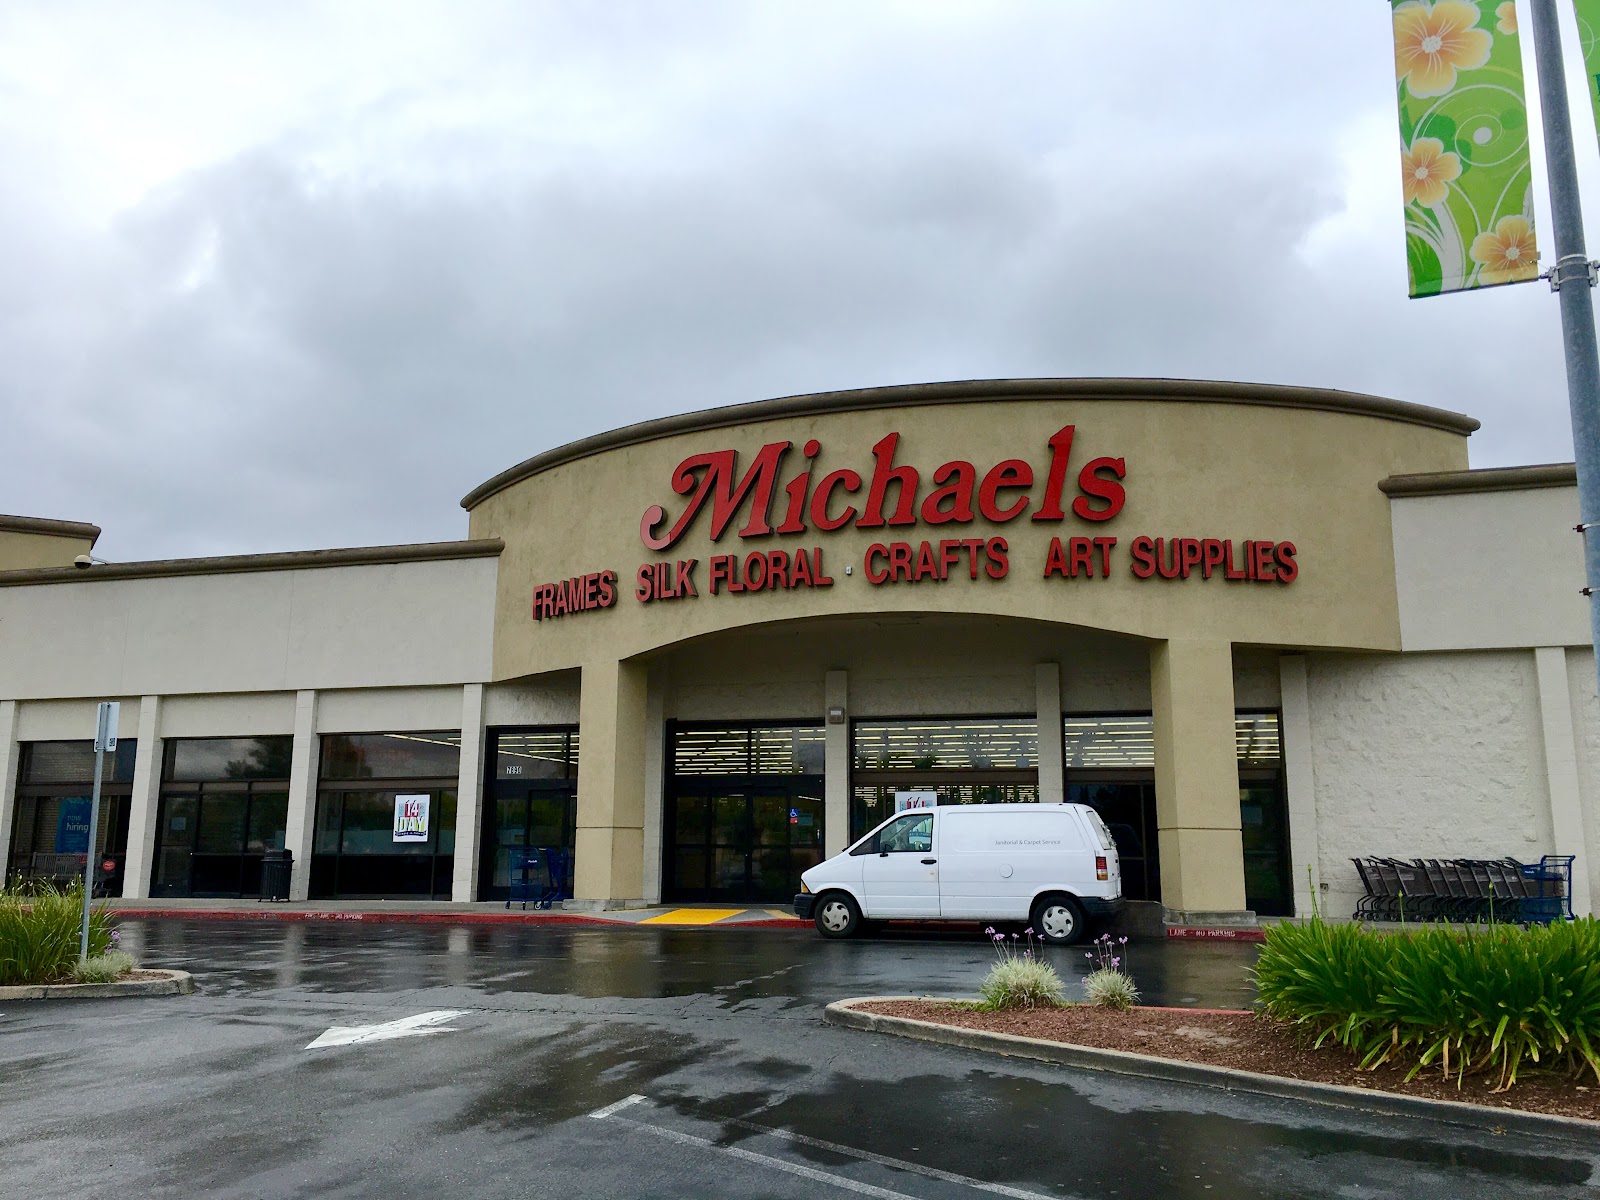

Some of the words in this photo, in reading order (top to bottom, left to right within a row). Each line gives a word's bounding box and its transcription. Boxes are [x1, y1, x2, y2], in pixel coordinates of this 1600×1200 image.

[640, 425, 1127, 551] Michaels
[532, 569, 618, 622] FRAMES
[635, 558, 699, 604] SILK
[709, 546, 834, 596] FLORAL
[864, 537, 1010, 586] CRAFTS
[1043, 537, 1118, 579] ART
[1131, 536, 1300, 584] SUPPLIES
[66, 822, 89, 834] hiring
[397, 815, 426, 833] DAY
[1169, 928, 1187, 937] LANE
